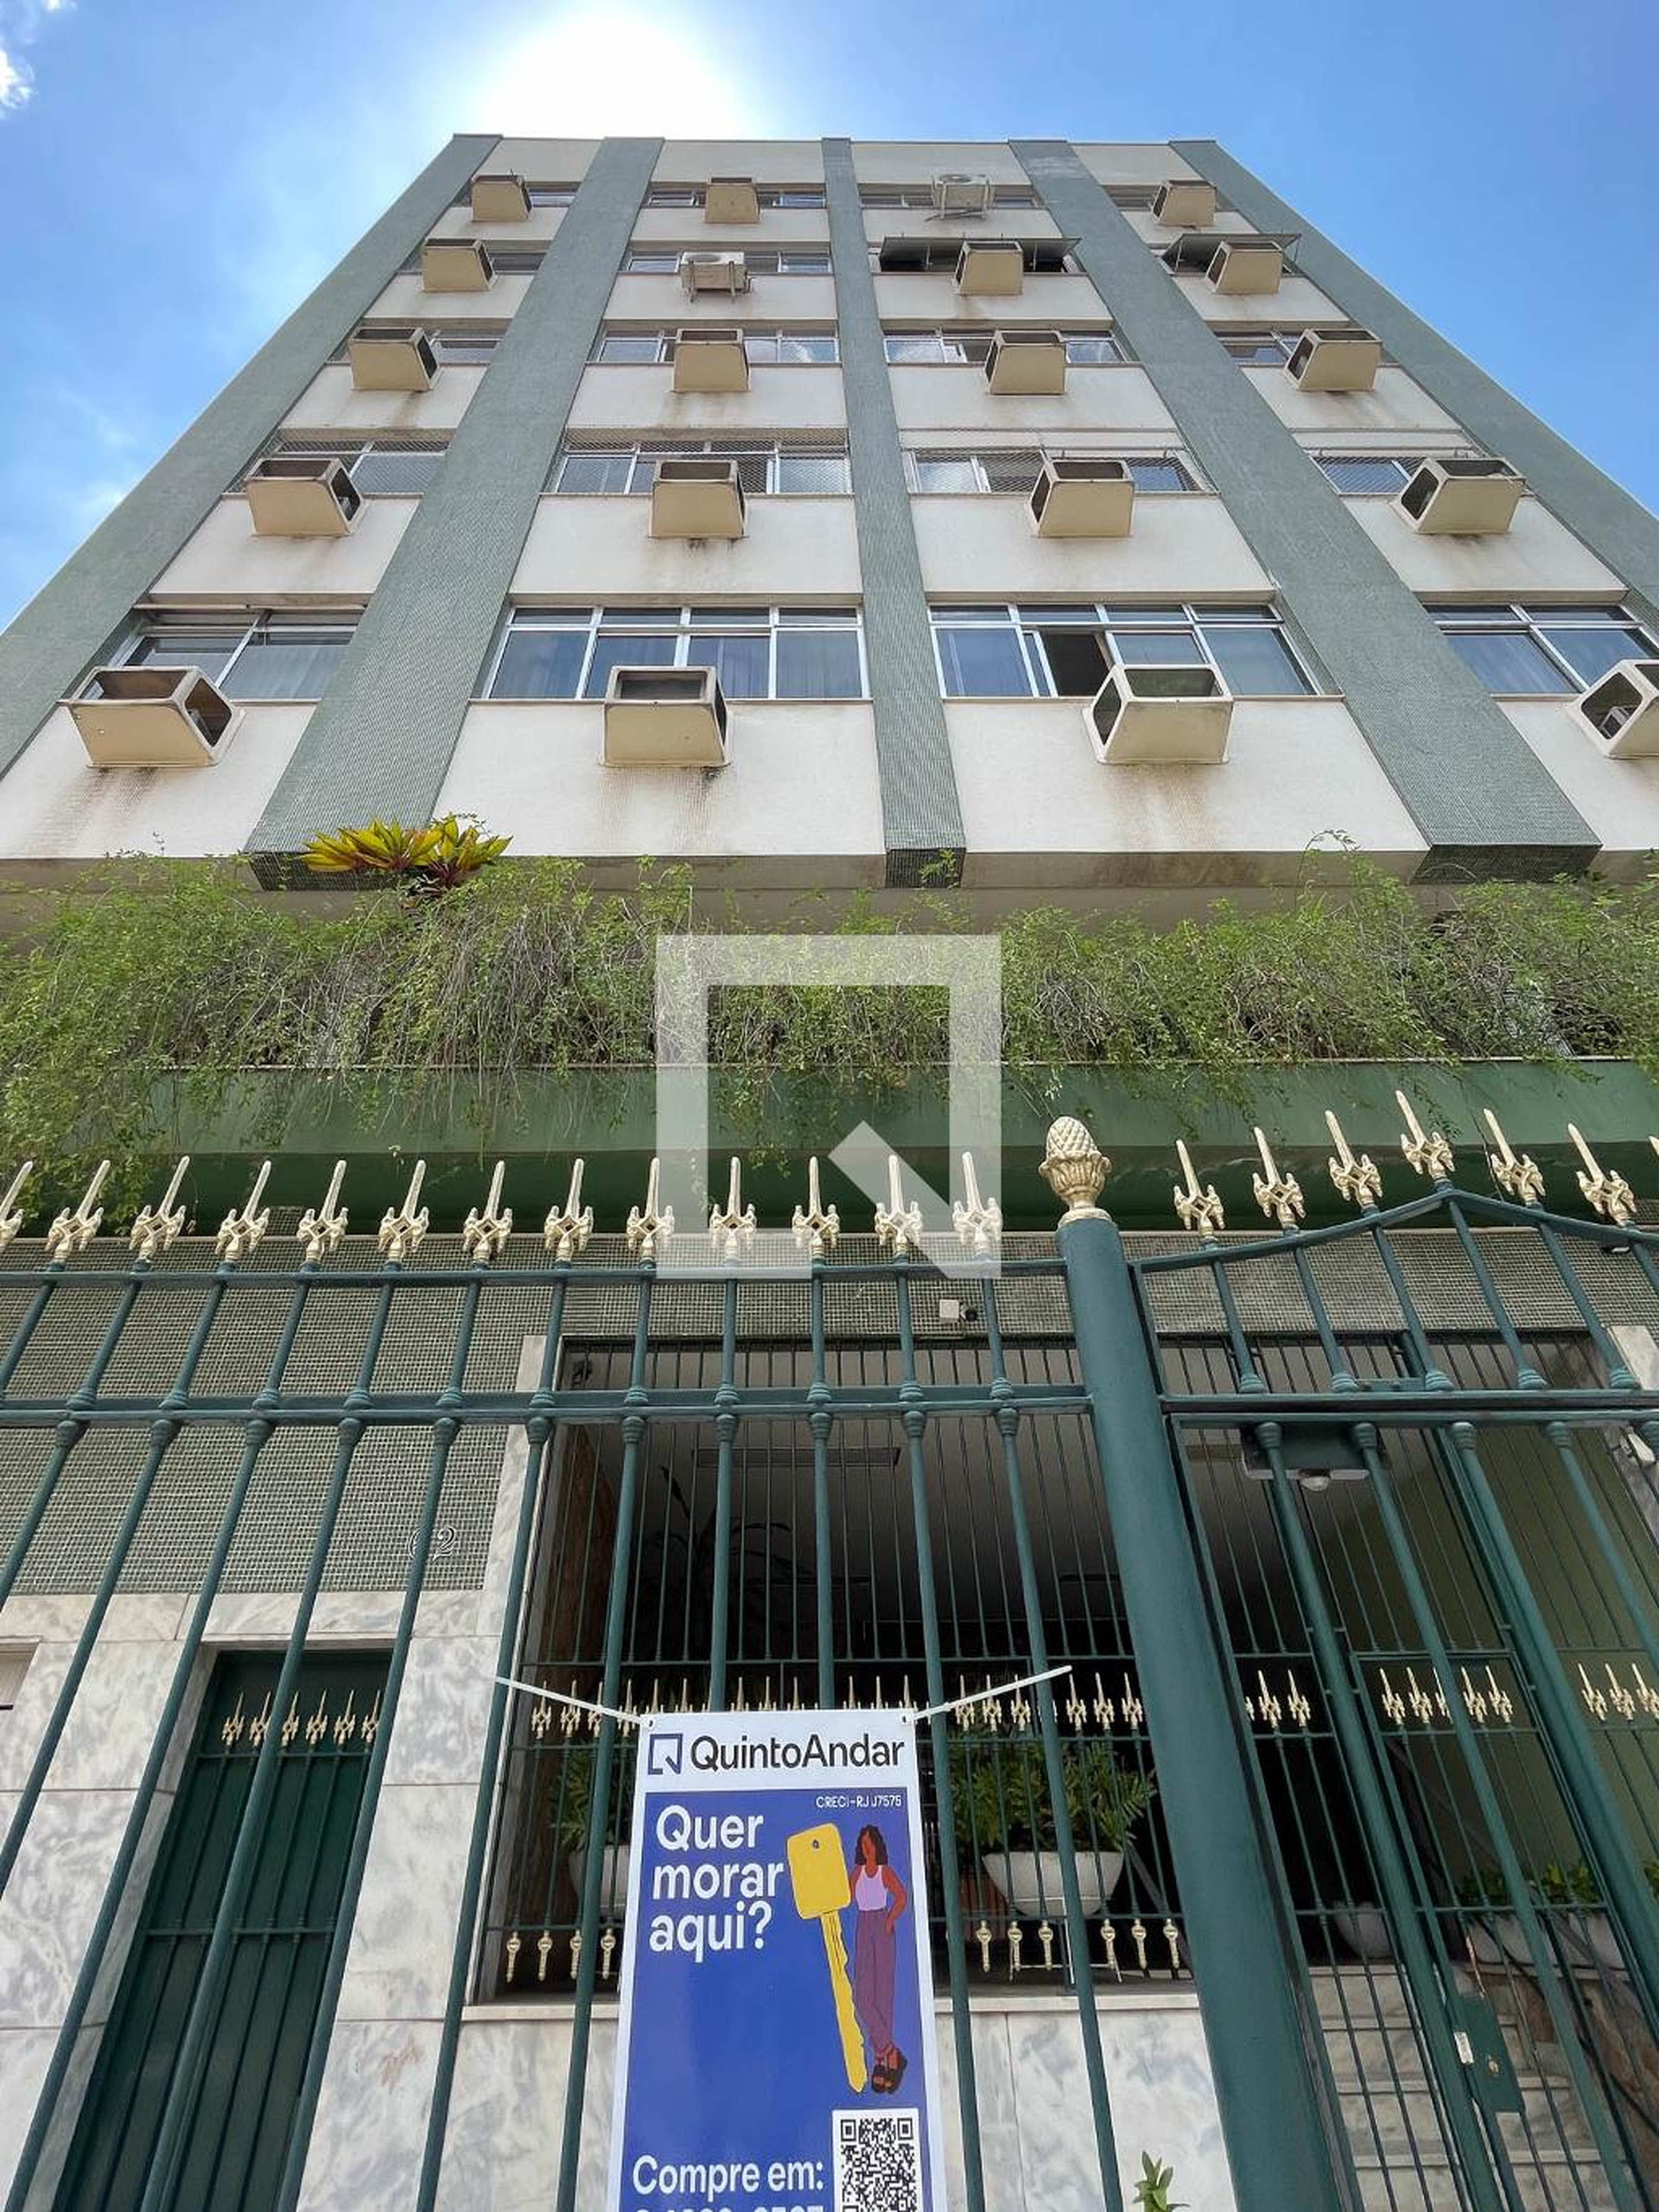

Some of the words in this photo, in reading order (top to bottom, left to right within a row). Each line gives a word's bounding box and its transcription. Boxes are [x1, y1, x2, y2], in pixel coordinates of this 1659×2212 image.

[691, 1734, 905, 1772] QuintoAndar
[656, 1805, 763, 1852] Quer
[652, 1862, 784, 1900] morar
[649, 1901, 772, 1963] aqui?
[633, 2155, 760, 2202] Compre
[767, 2161, 823, 2191] em:
